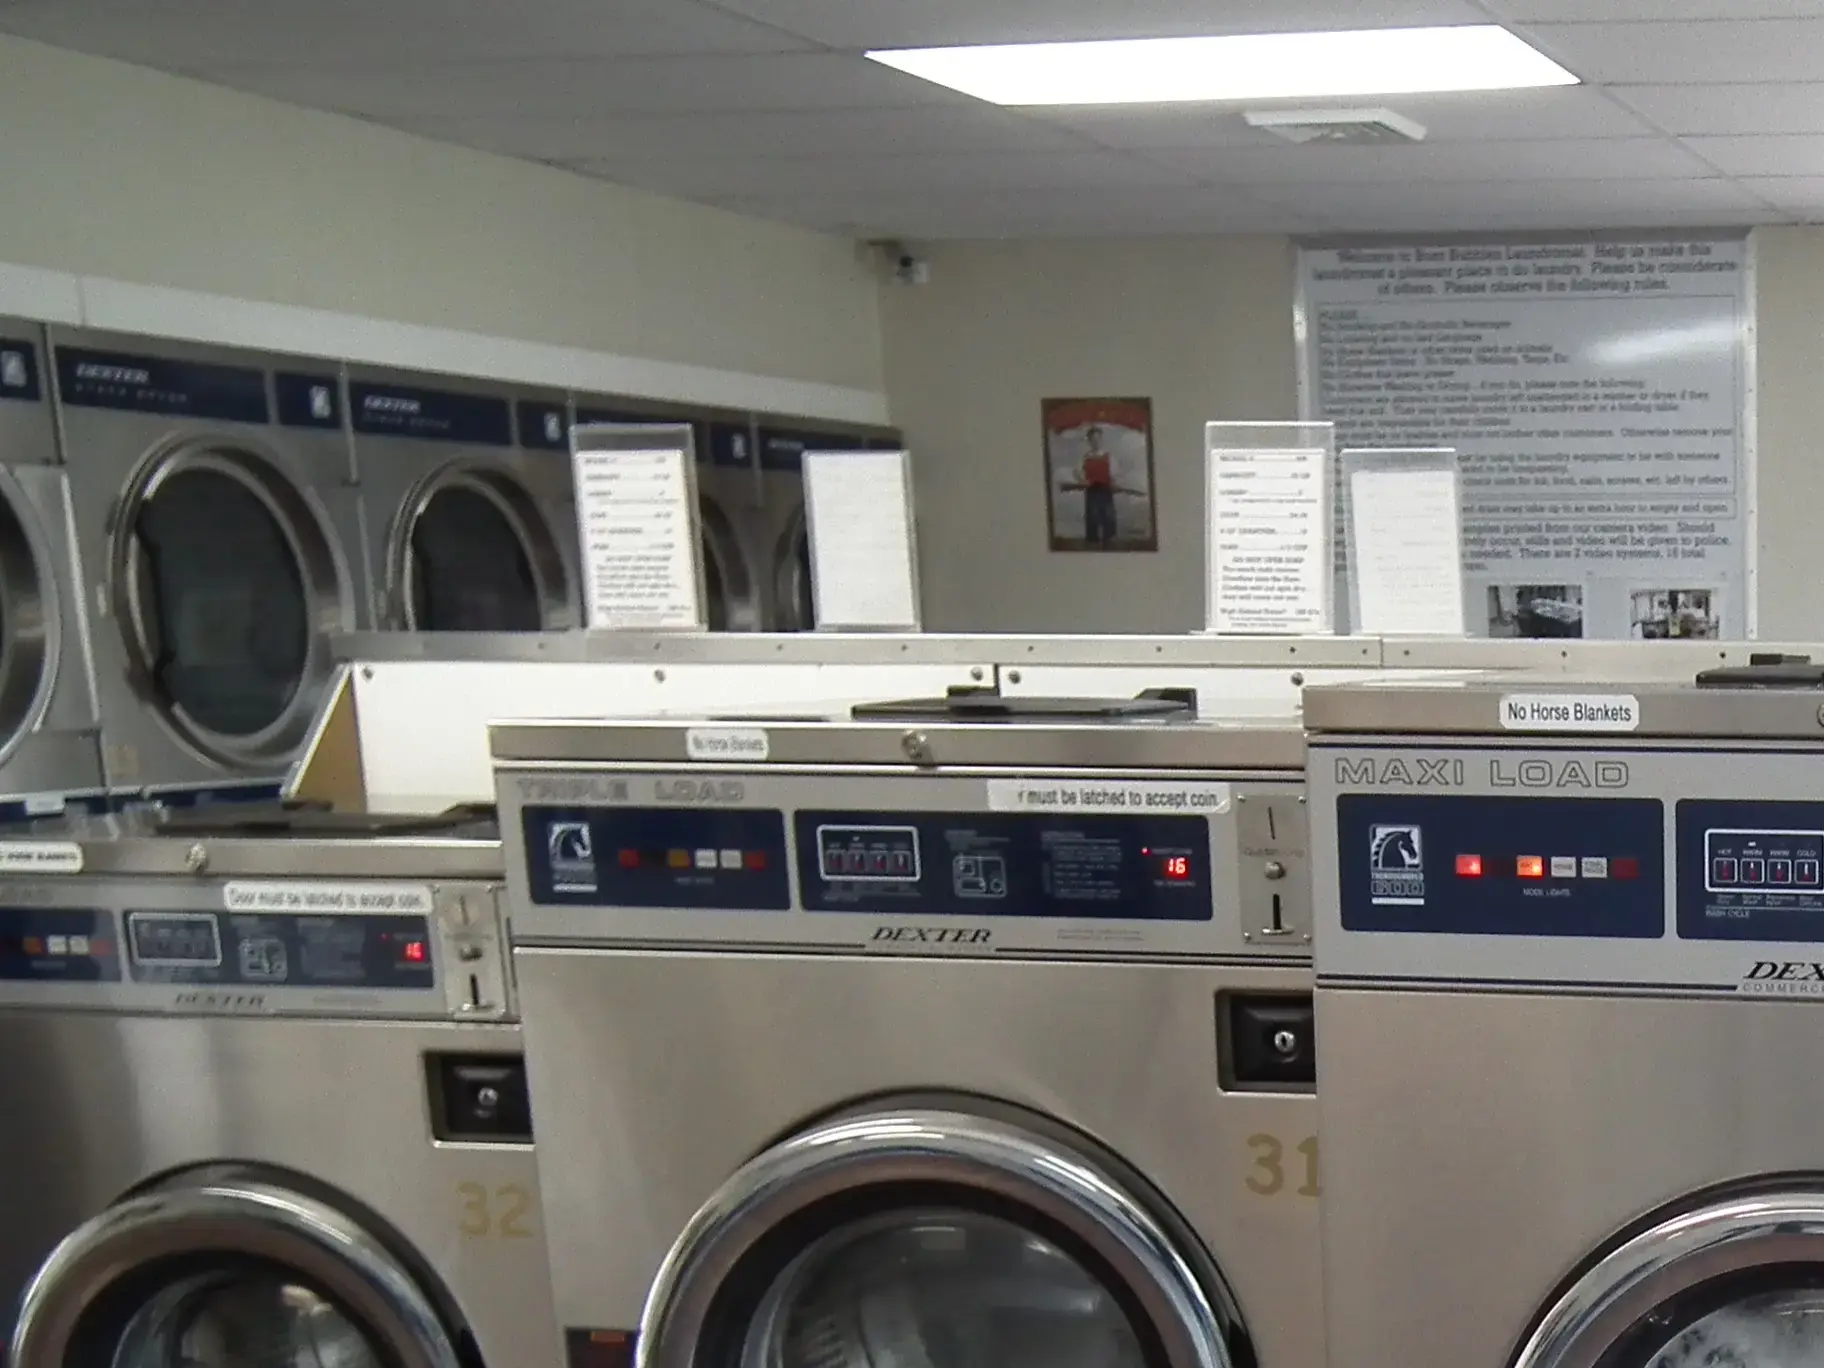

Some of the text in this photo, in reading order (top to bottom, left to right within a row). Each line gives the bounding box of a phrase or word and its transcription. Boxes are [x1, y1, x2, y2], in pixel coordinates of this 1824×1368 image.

[1507, 702, 1632, 723] No Horse Blankets
[1334, 757, 1630, 789] MAXI LOAD
[516, 777, 746, 801] TRIPLE LOAD
[1028, 788, 1058, 805] must
[1060, 788, 1077, 805] be
[1079, 788, 1126, 806] latched
[1129, 790, 1143, 806] to
[1145, 791, 1188, 809] accept
[1167, 857, 1187, 875] 16
[871, 926, 993, 944] DEXTER
[1245, 1132, 1323, 1198] 31
[455, 1180, 534, 1239] 32
